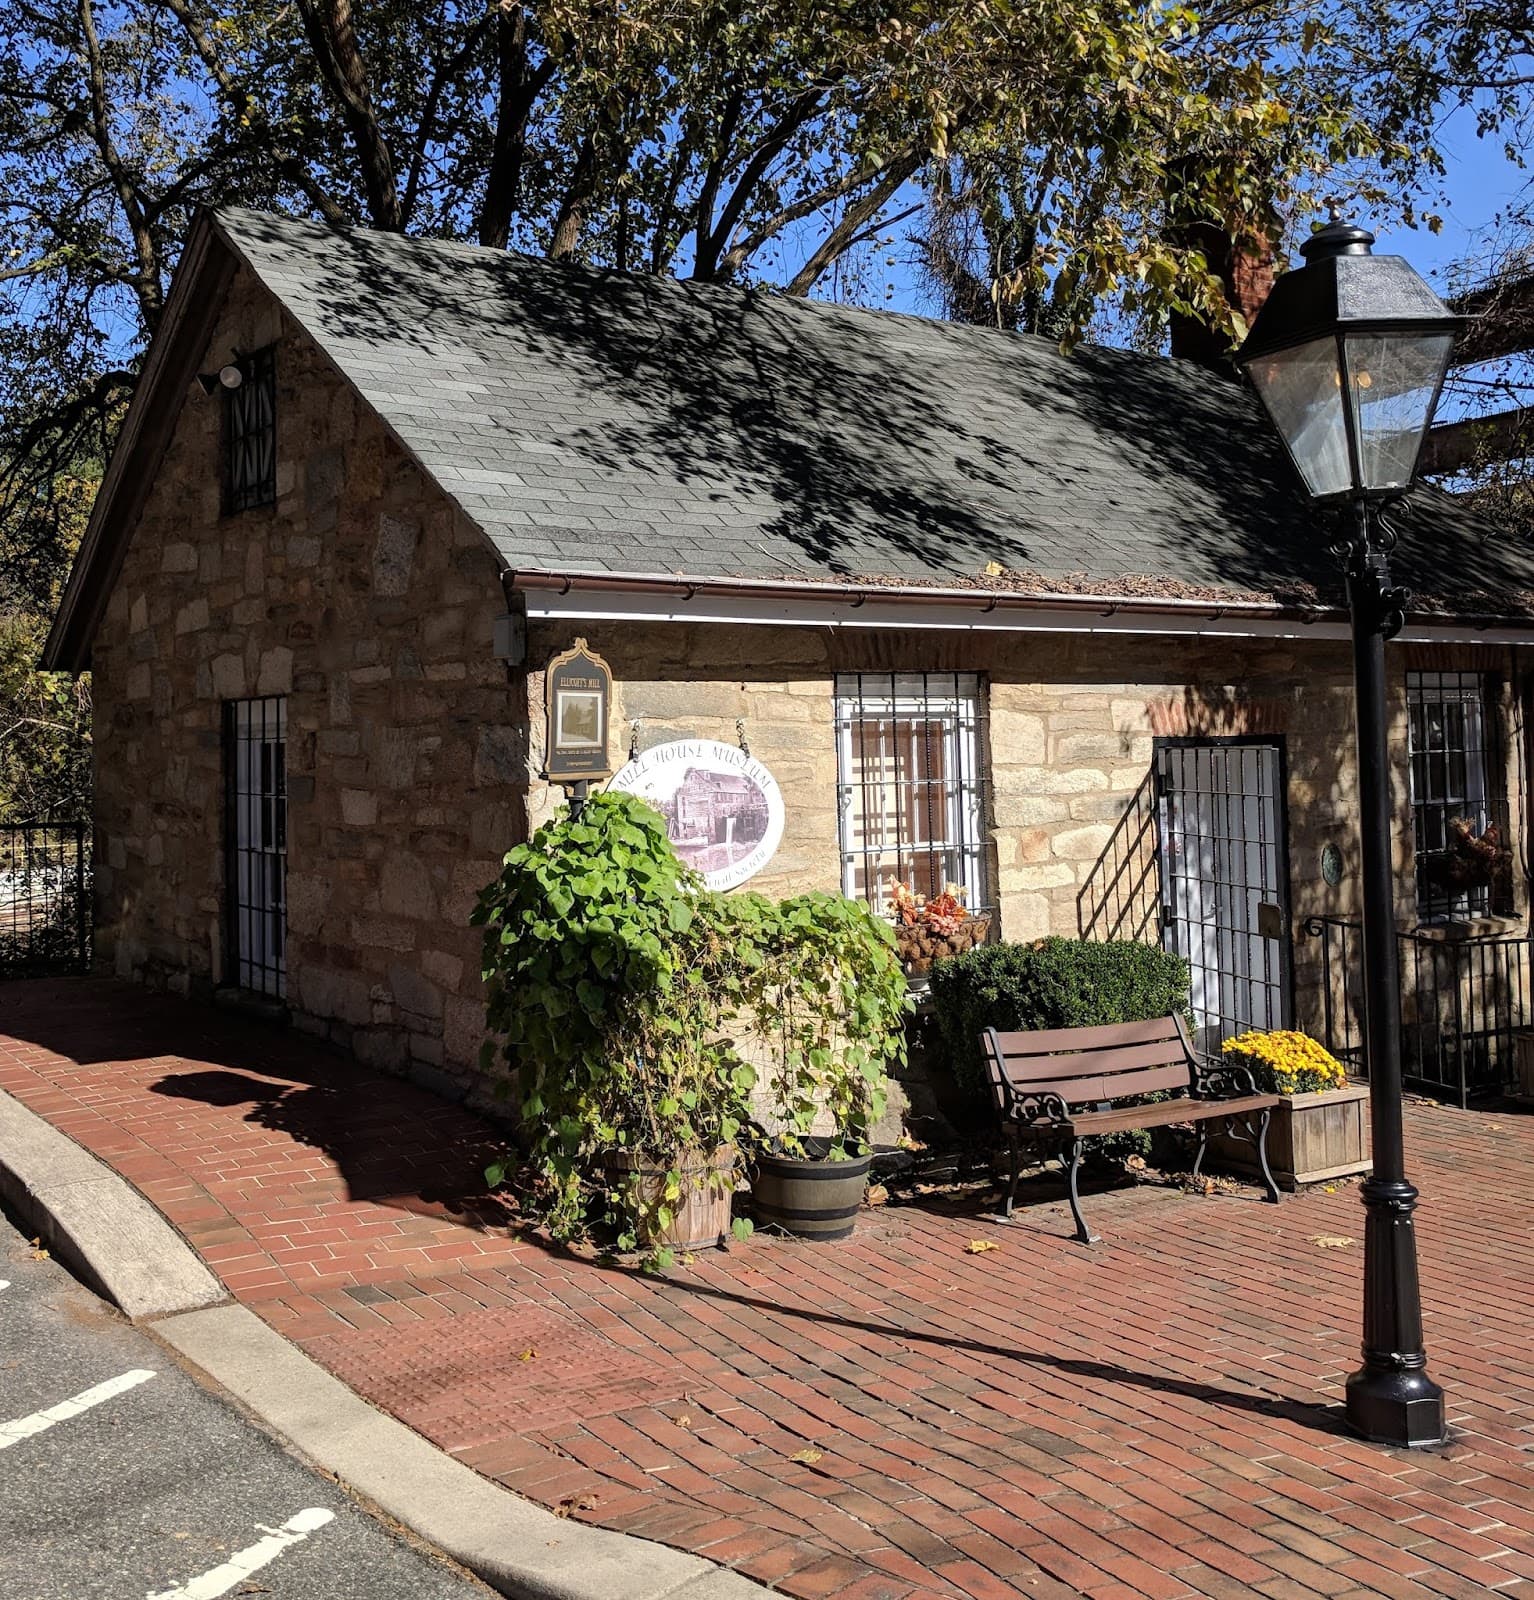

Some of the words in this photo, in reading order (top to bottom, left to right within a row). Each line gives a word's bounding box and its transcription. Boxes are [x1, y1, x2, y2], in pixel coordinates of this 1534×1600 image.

[588, 679, 600, 688] MILL
[654, 744, 703, 763] HOUSE
[712, 745, 771, 789] MUSEUM
